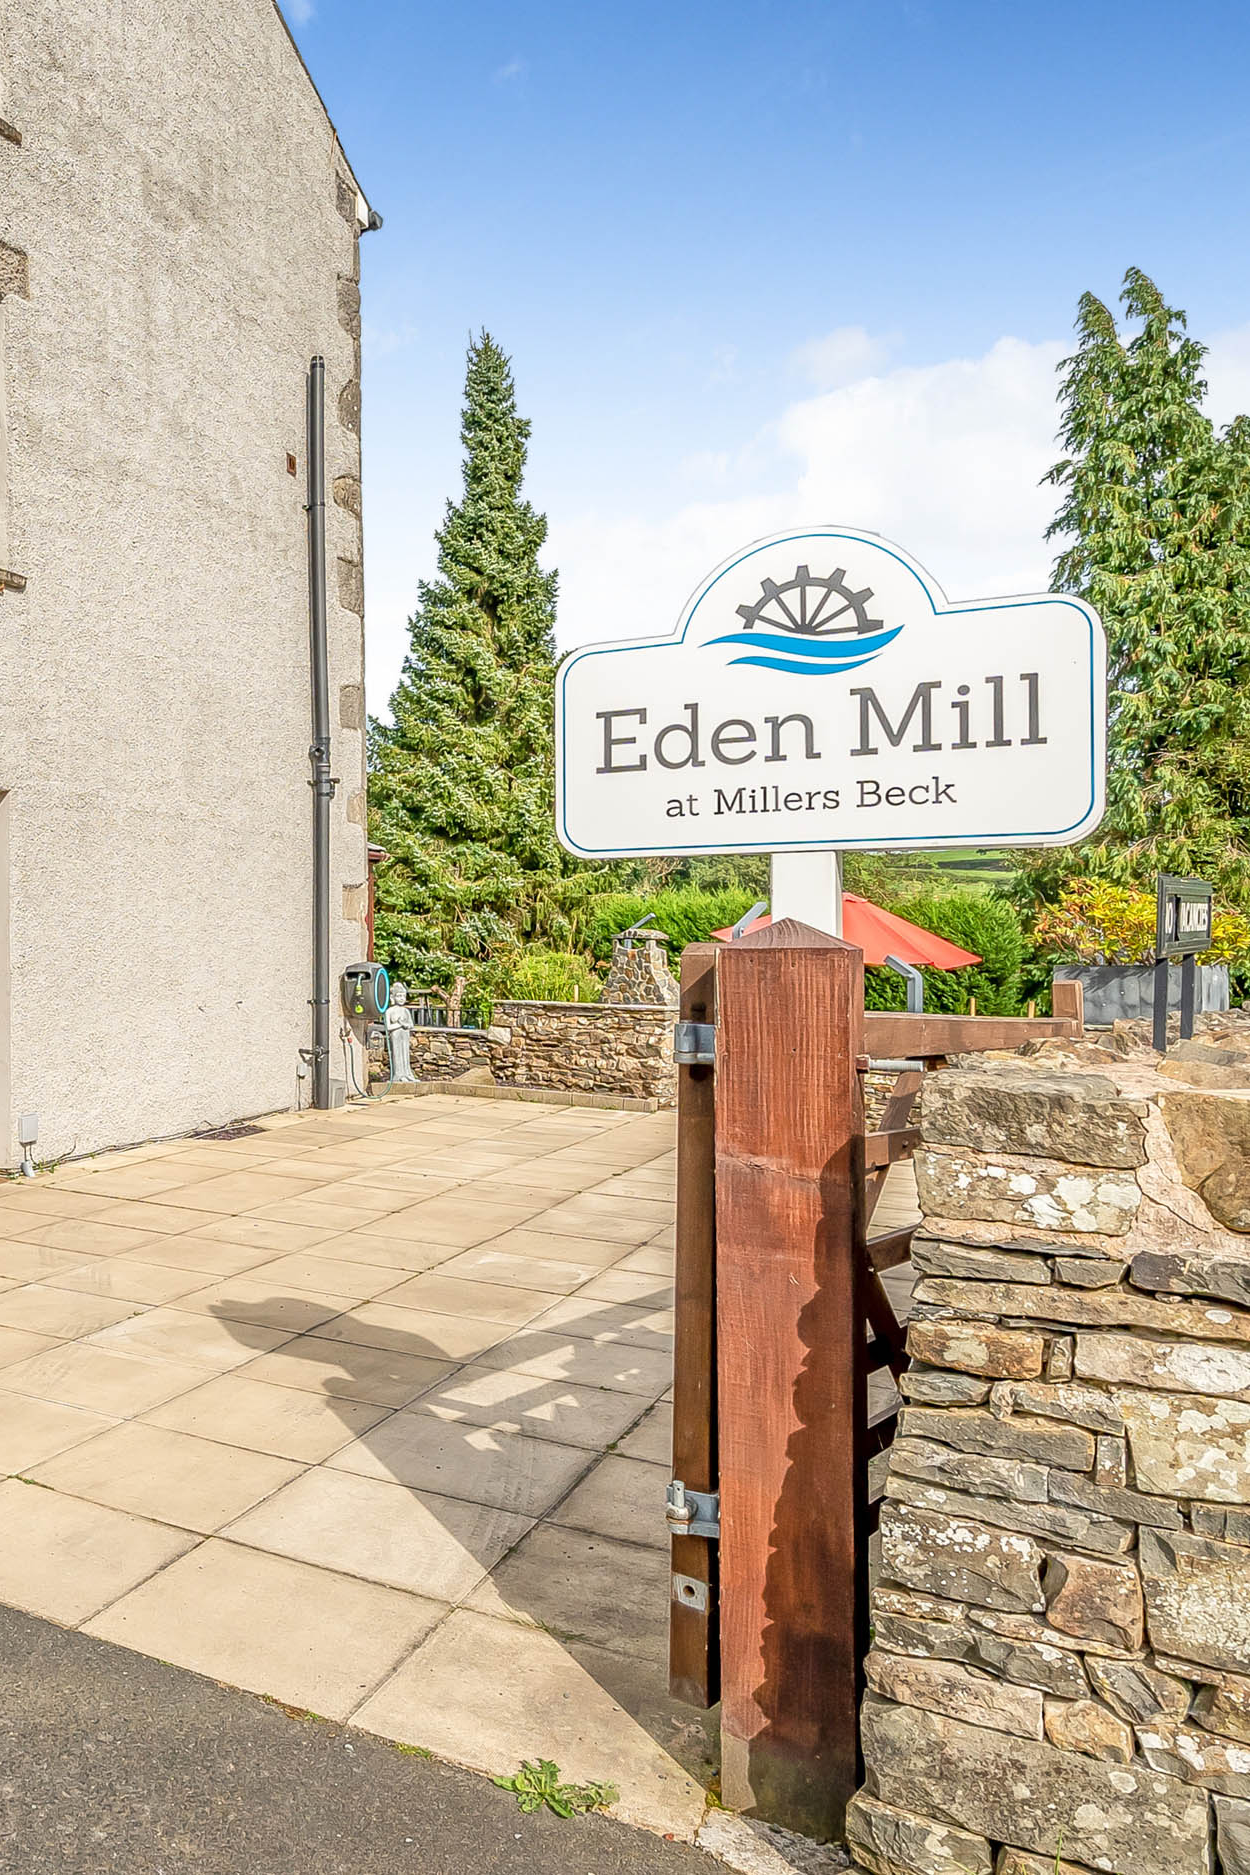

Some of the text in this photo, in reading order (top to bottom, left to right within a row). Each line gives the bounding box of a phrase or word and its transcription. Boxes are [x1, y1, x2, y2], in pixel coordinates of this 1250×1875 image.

[595, 672, 1048, 775] Eden Mill
[665, 776, 957, 818] at Millers Beck
[1179, 902, 1209, 932] ACANCIES
